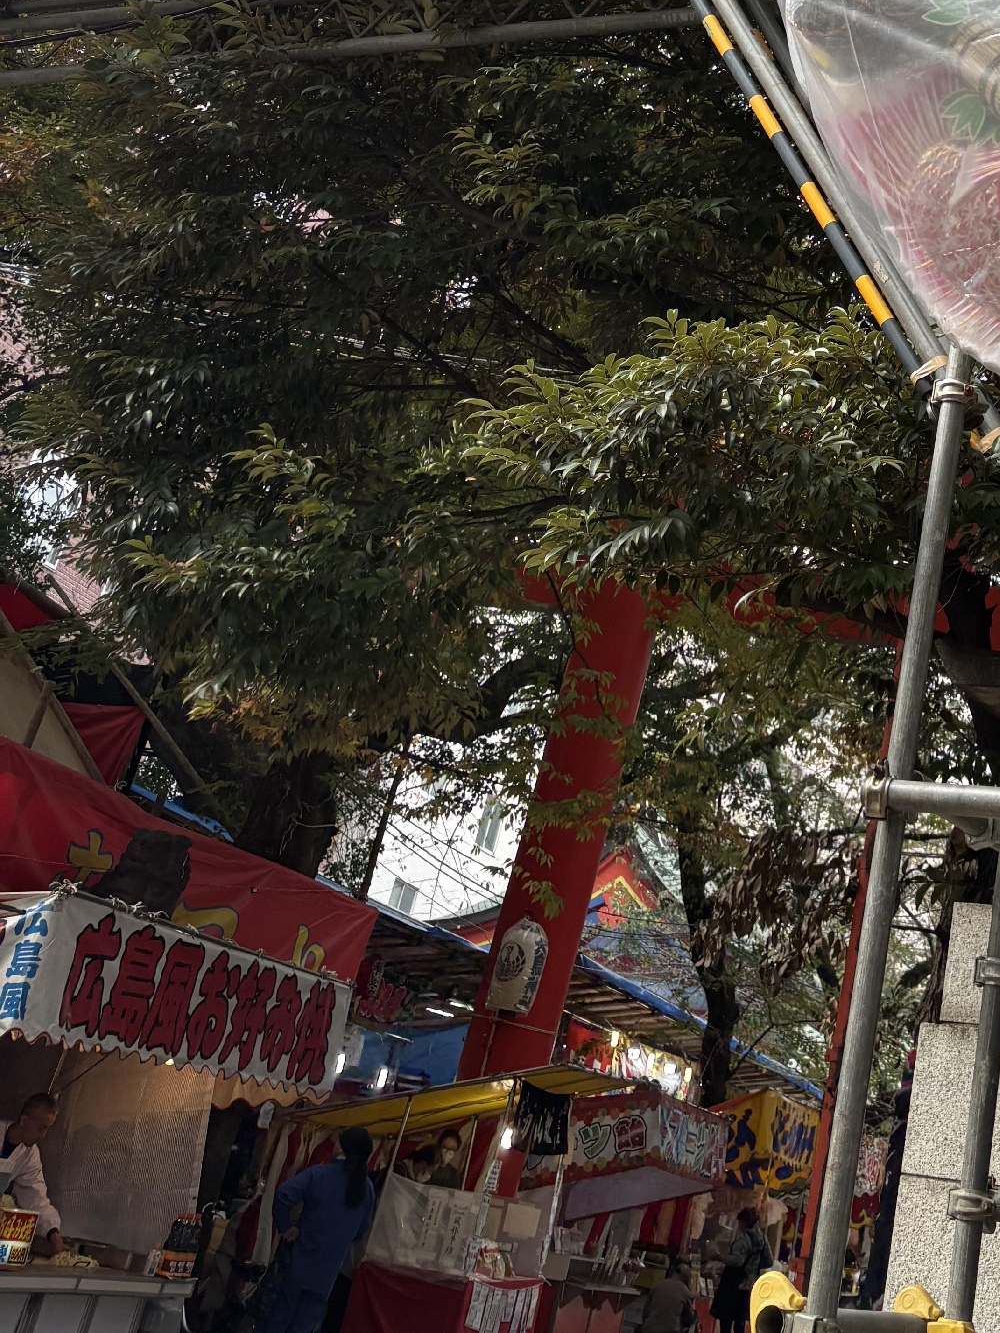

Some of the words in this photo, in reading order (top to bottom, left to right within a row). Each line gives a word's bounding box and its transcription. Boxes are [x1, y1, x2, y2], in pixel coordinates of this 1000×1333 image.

[1, 901, 50, 1022] 広島風
[58, 911, 337, 1087] 広島風お好み焼
